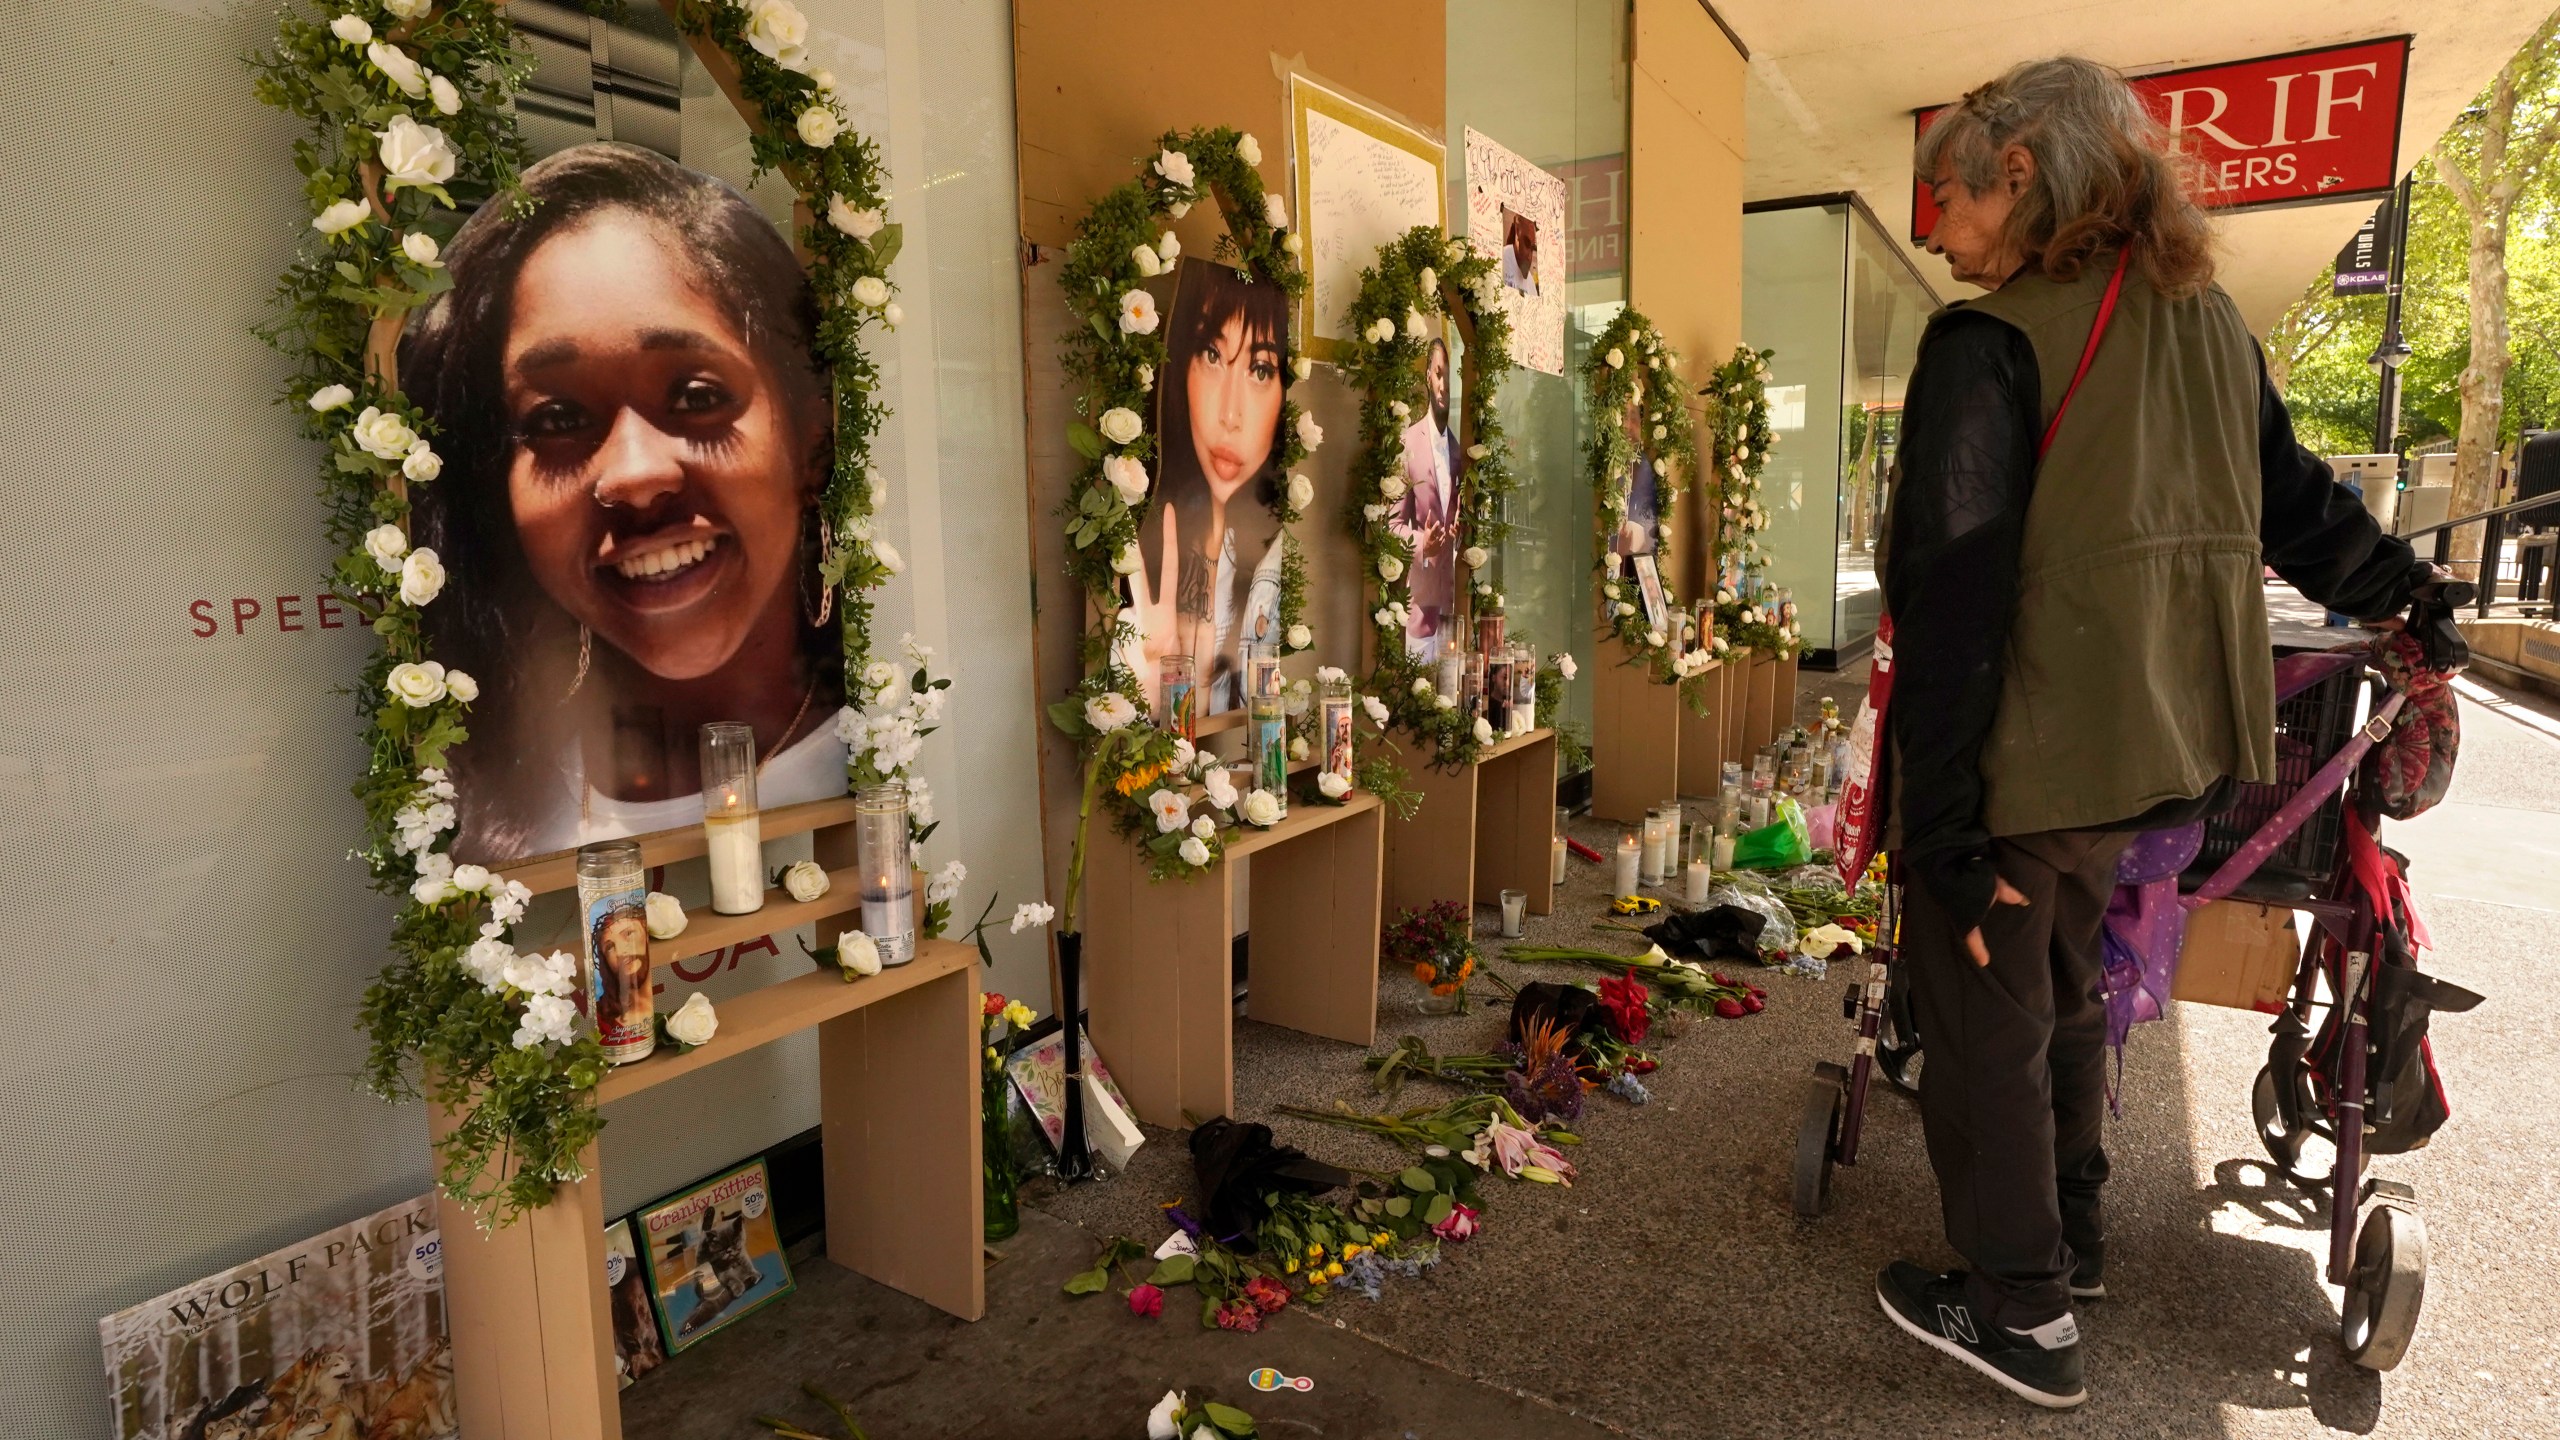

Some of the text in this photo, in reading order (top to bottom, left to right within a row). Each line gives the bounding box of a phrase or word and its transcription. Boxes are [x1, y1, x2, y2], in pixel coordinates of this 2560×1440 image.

[2160, 62, 2377, 157] RIF
[2180, 153, 2298, 194] ELERS
[2356, 233, 2374, 268] WALLS
[2350, 274, 2386, 283] KOLAS
[649, 1171, 762, 1232] Cranky Kitties
[744, 1191, 765, 1206] 50%
[167, 1207, 430, 1328] WOLF PACK
[606, 1254, 622, 1270] 0%
